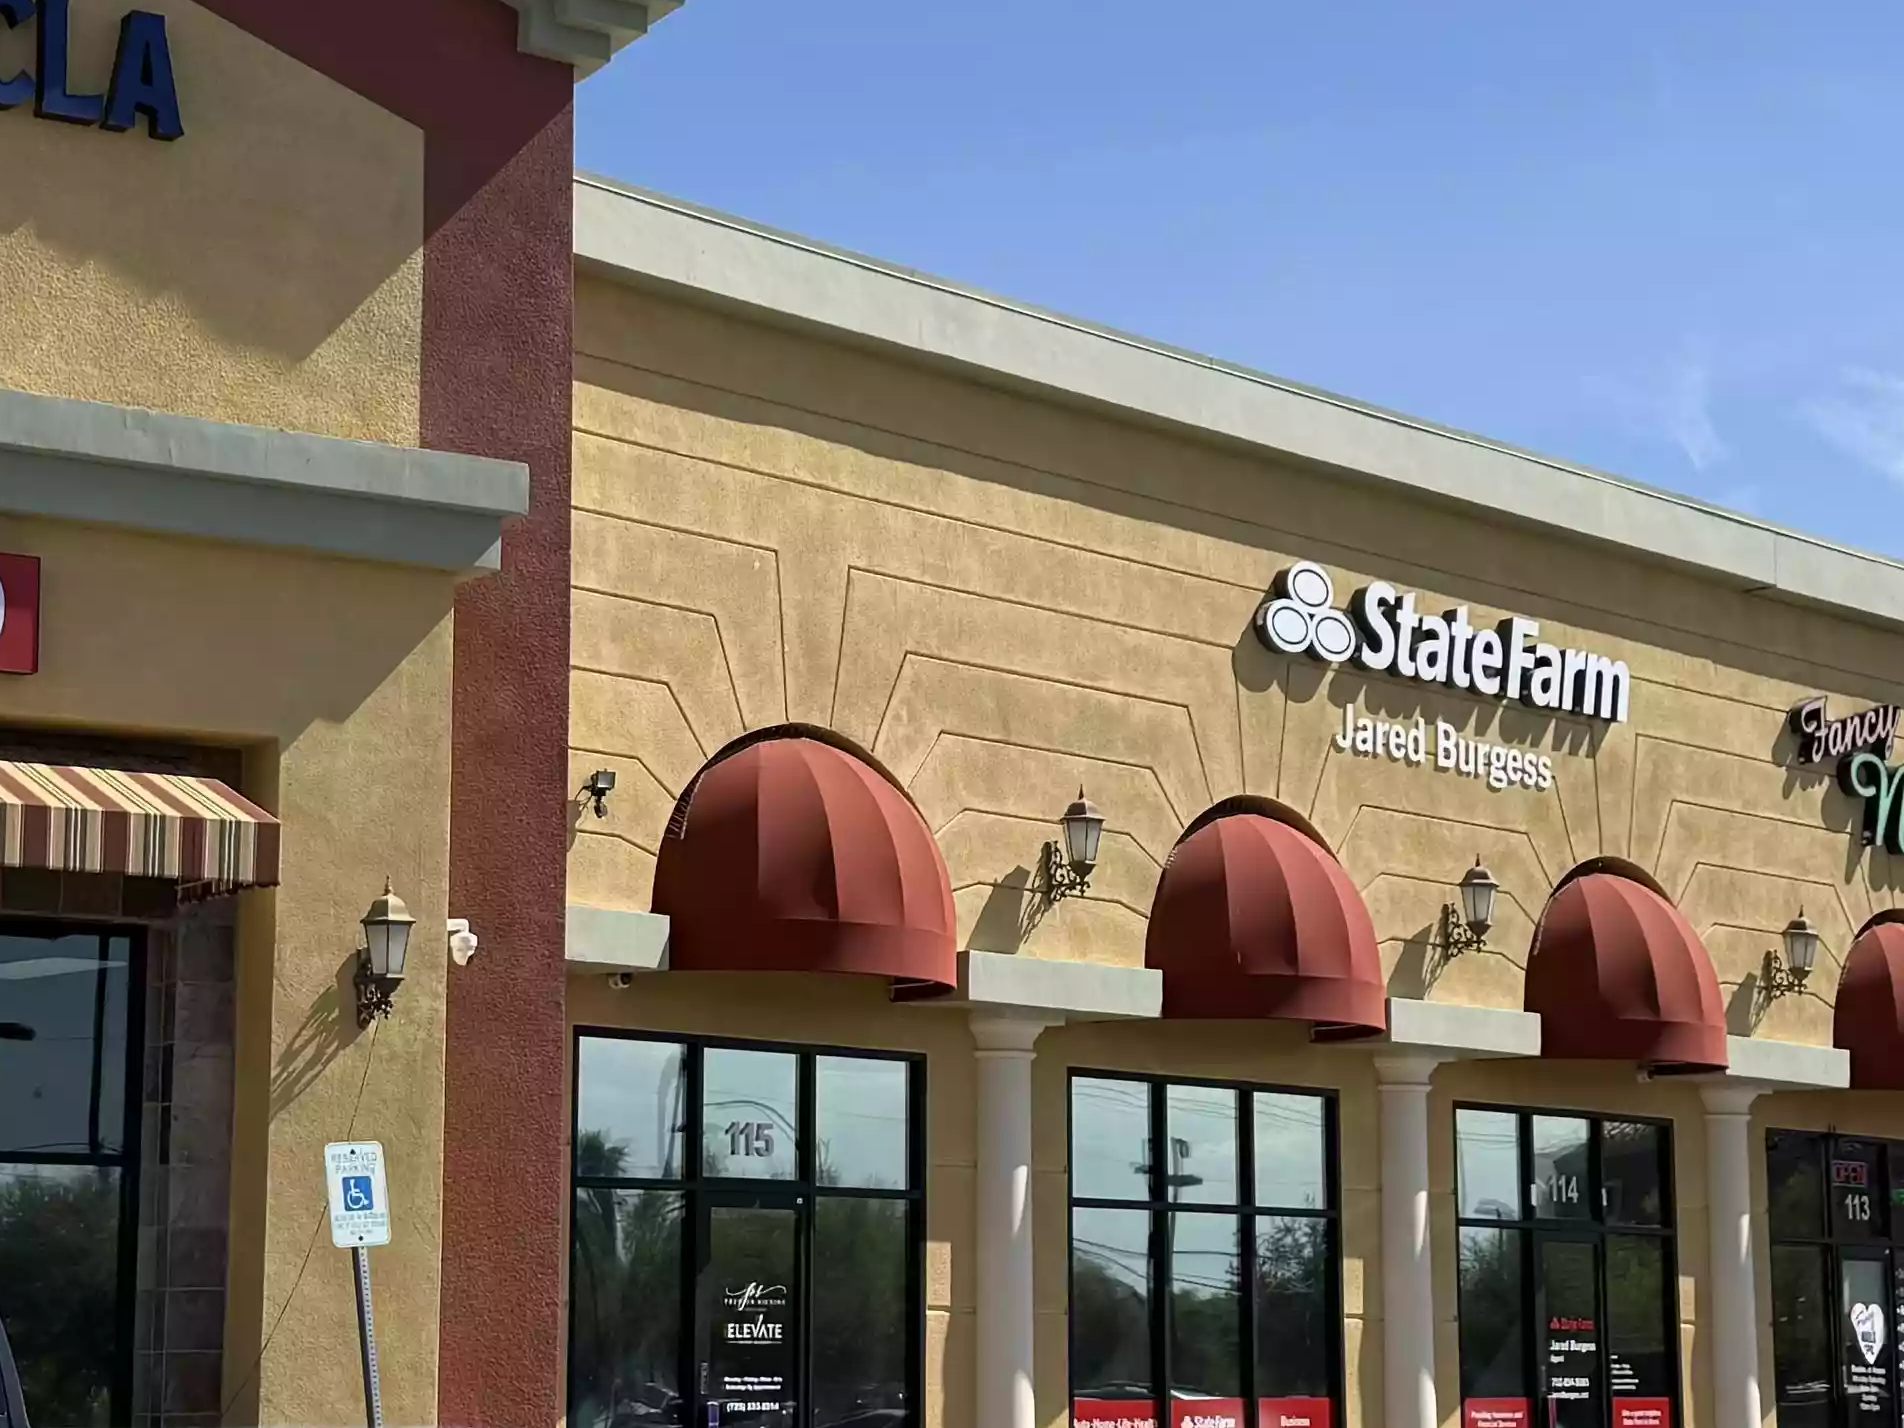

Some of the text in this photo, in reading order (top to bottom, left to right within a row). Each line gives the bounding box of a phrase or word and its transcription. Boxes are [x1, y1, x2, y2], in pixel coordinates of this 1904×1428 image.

[1799, 695, 1899, 763] Fancy
[1335, 702, 1554, 791] Jared Burgess
[725, 1121, 775, 1158] 115
[1549, 1173, 1579, 1204] 114
[1844, 1193, 1871, 1221] 113
[727, 1314, 783, 1339] ELEVATE
